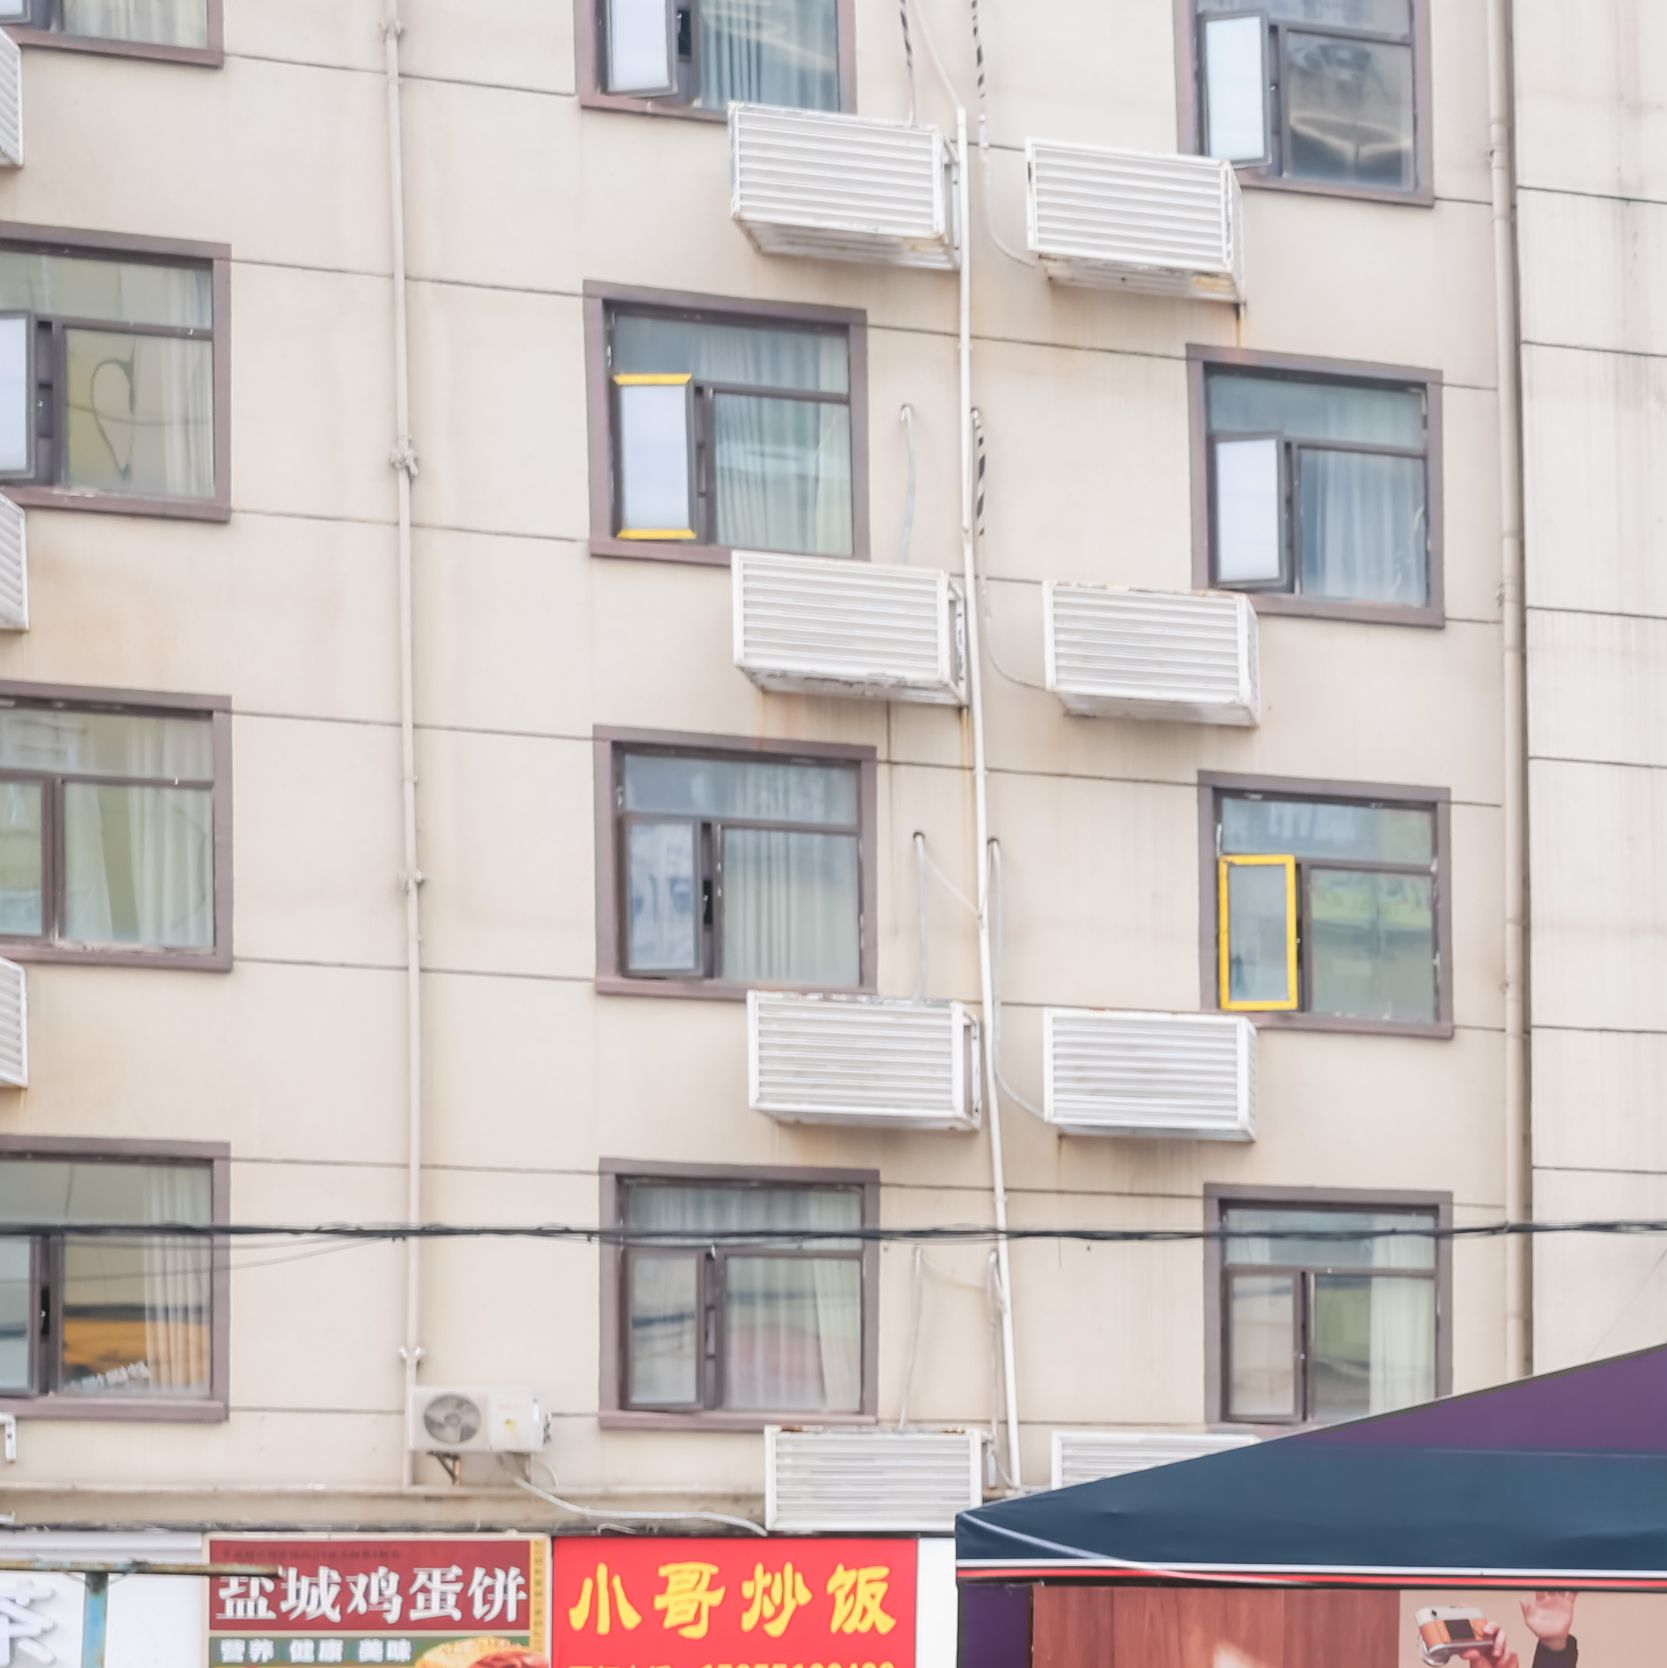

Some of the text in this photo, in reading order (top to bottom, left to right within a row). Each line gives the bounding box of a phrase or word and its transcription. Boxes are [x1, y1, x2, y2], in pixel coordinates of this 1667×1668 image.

[216, 1565, 528, 1624] 盐城鸡蛋饼
[569, 1562, 897, 1640] 小哥炒饭
